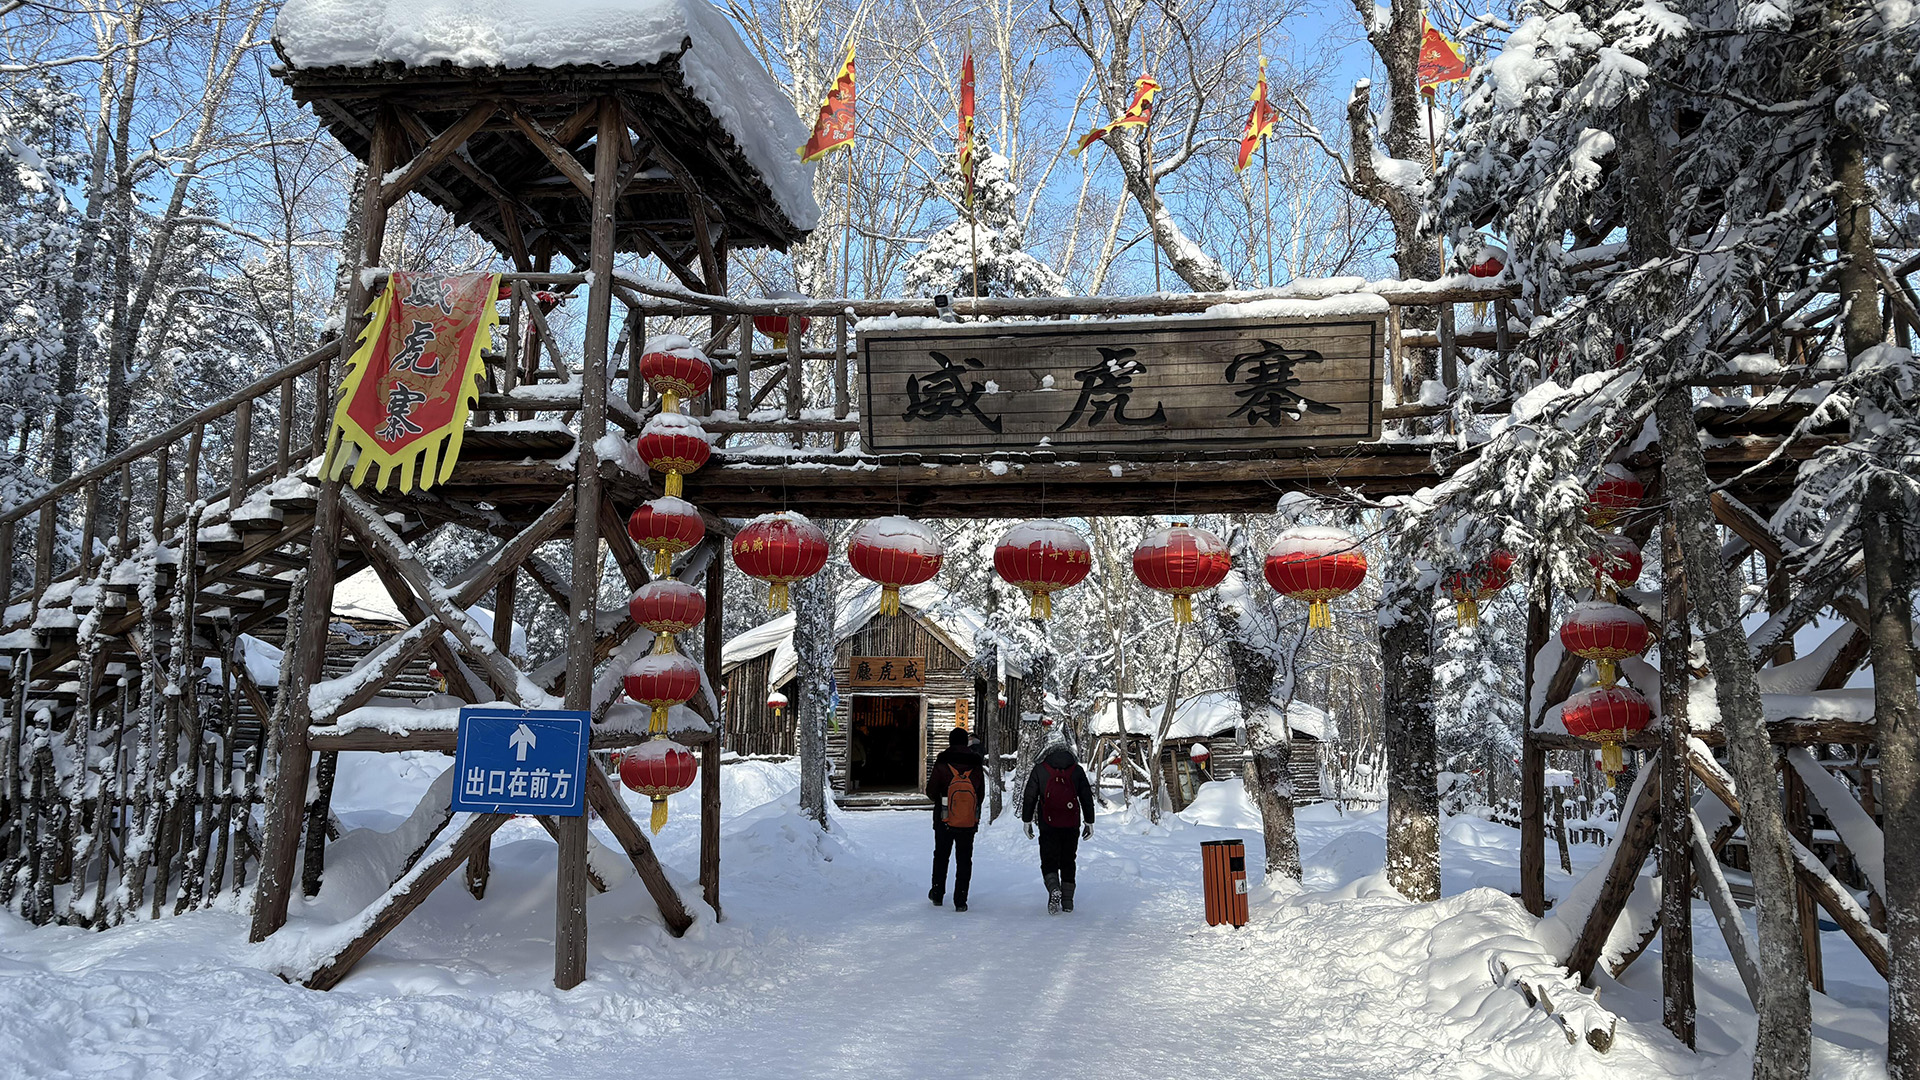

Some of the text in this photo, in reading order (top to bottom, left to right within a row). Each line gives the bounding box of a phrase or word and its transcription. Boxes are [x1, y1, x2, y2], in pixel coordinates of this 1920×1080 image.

[376, 275, 453, 442] 威虎寨
[901, 338, 1341, 434] 威虎寨
[465, 766, 572, 799] 出口在前方
